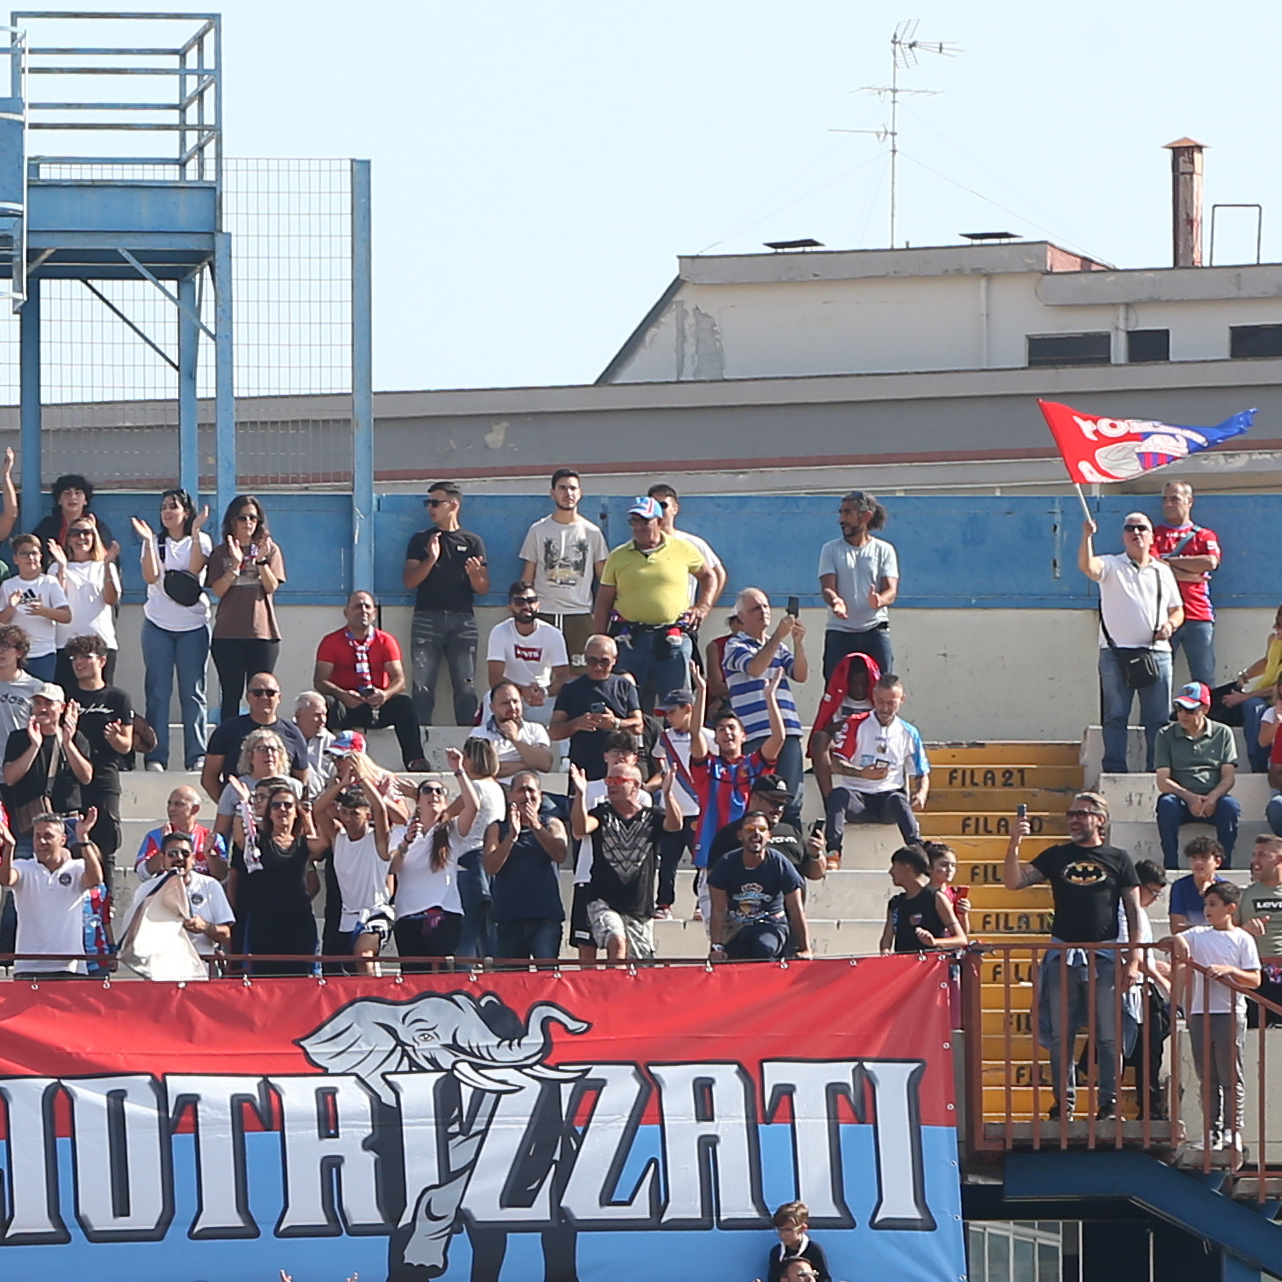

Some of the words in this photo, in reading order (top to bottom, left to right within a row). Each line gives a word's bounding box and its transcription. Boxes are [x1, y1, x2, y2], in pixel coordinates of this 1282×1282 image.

[948, 768, 996, 787] FILA
[1001, 768, 1026, 787] 21
[961, 818, 1010, 836] FILA
[971, 865, 1003, 883] FIL
[983, 915, 1029, 931] FILA
